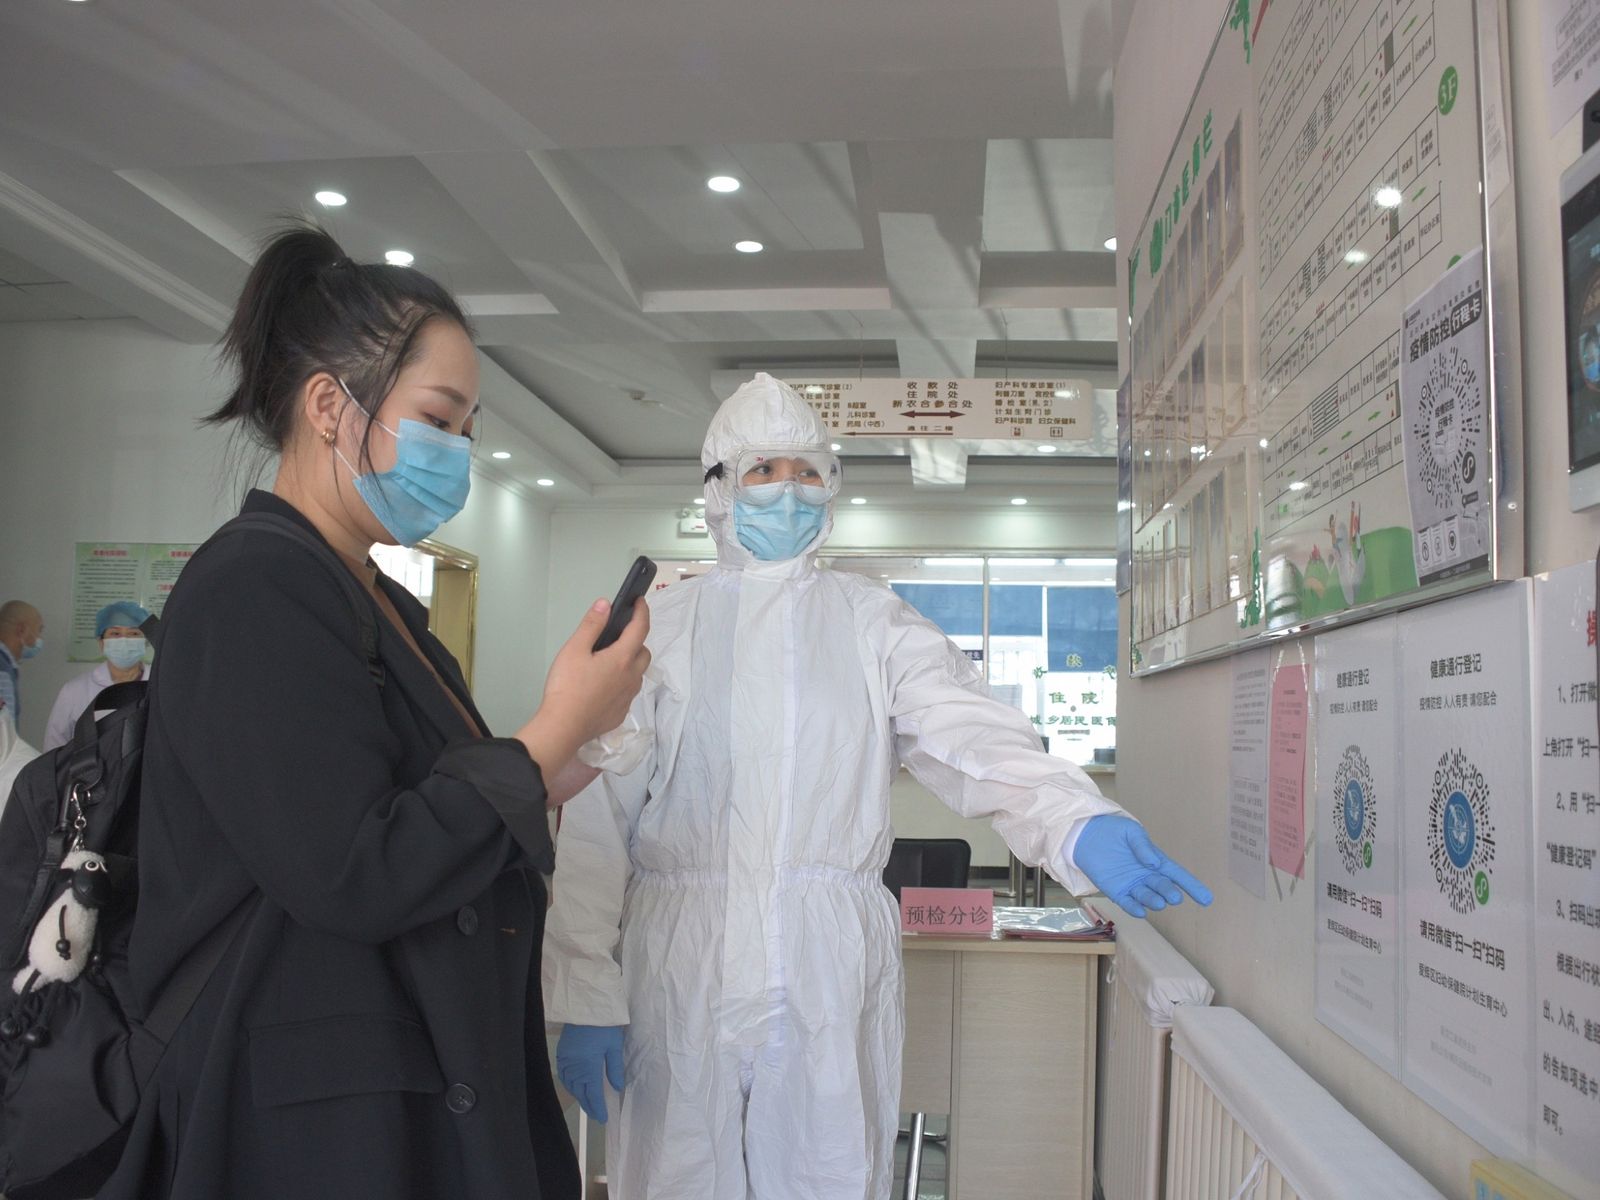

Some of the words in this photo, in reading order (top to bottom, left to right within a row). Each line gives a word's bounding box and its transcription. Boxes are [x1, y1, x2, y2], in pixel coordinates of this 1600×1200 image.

[1410, 317, 1450, 363] 疫情防控
[1452, 298, 1480, 331] 行程卡
[907, 382, 958, 390] 收款处
[907, 391, 958, 399] 住院处
[1430, 653, 1482, 679] 健康通行登记
[1336, 668, 1370, 689] 健康通行登记
[1049, 691, 1099, 705] 住院
[1444, 693, 1468, 709] 人人有责
[1469, 691, 1497, 707] 请您配合
[906, 905, 988, 925] 预检分诊
